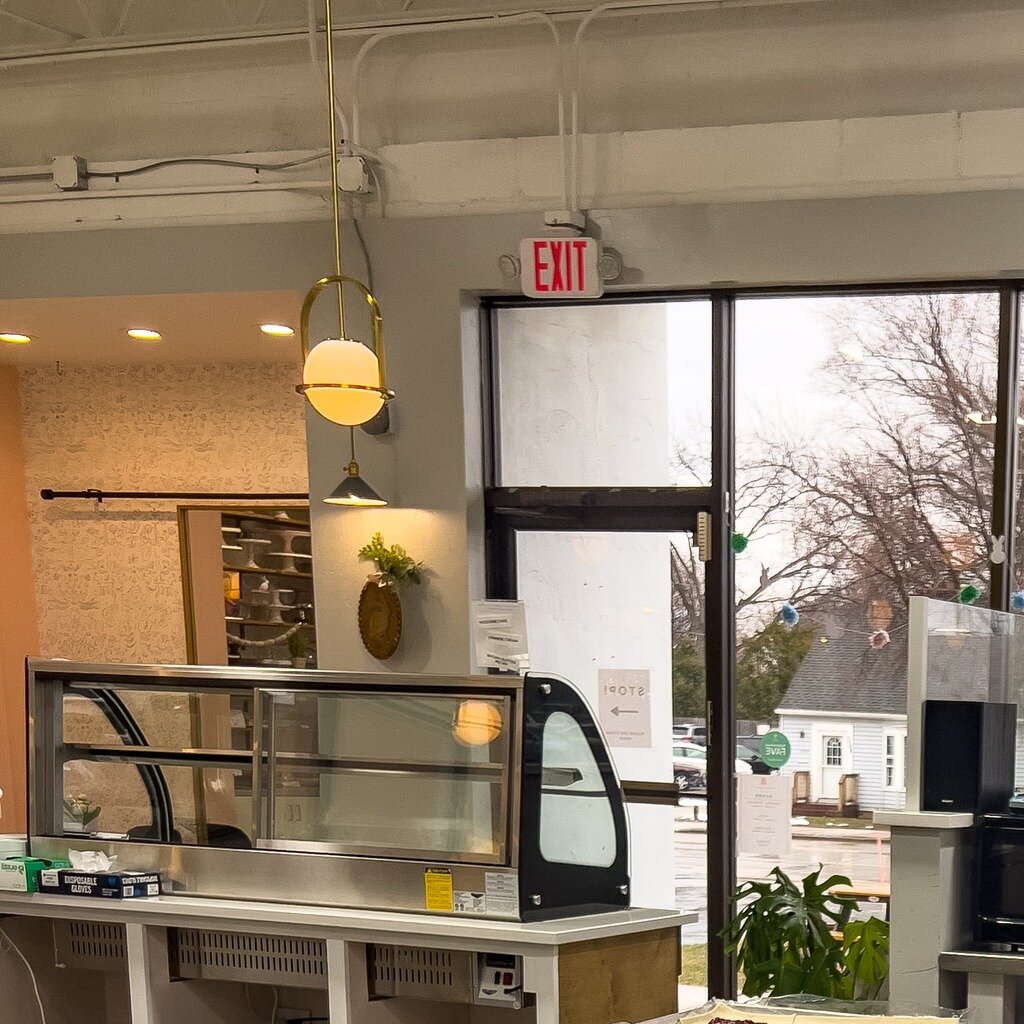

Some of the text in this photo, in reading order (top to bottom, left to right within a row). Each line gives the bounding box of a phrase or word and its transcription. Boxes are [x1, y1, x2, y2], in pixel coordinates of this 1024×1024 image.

[534, 241, 587, 292] EXIT
[64, 875, 97, 886] DISPOSABLE
[71, 884, 92, 894] GLOVES
